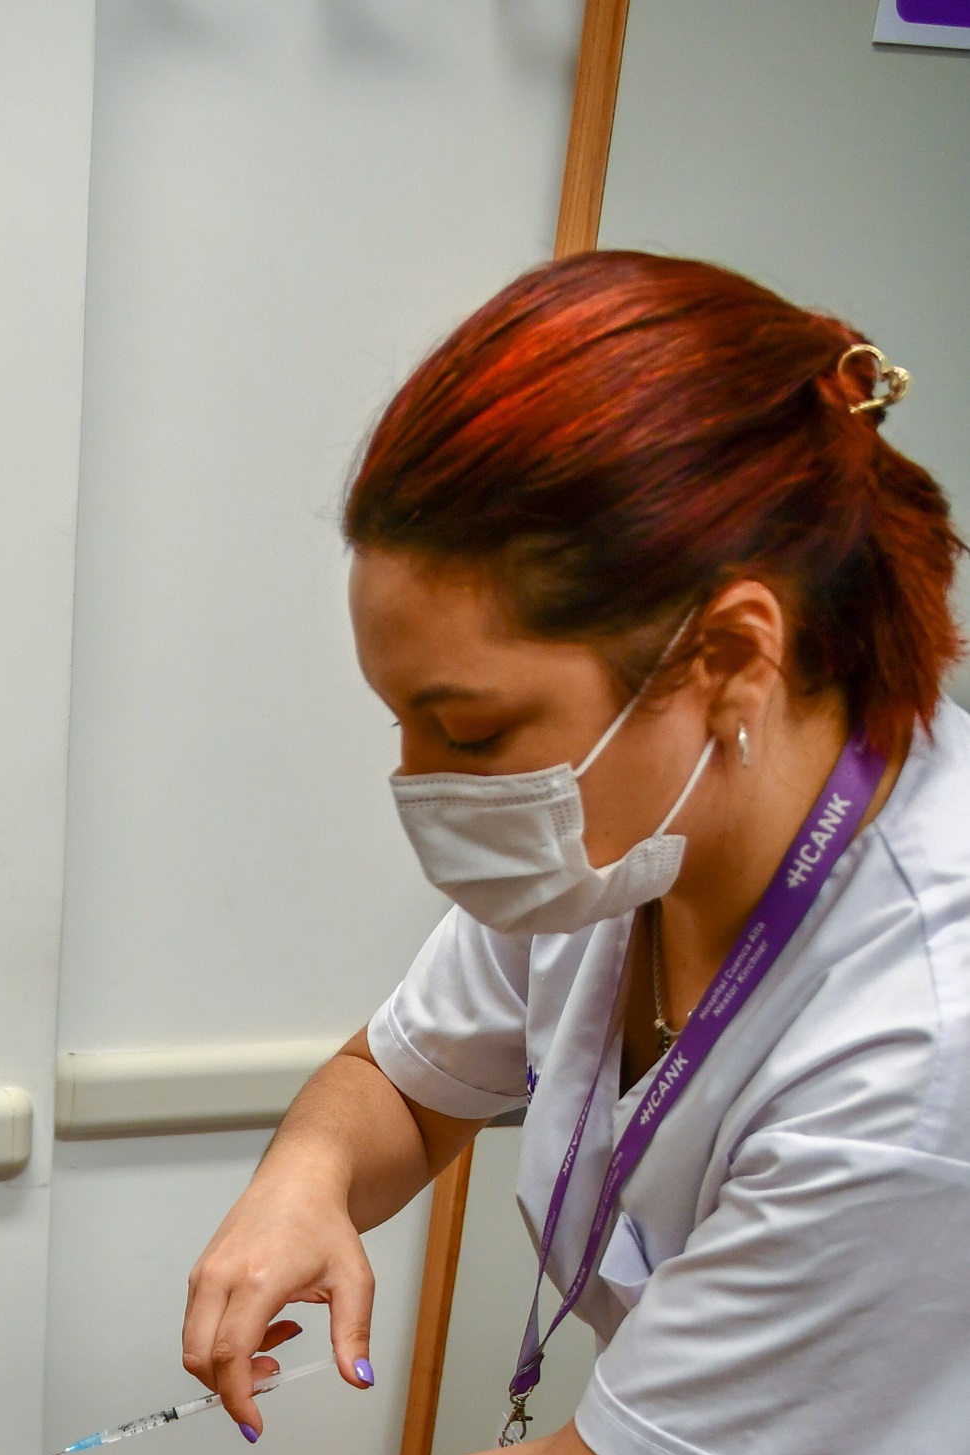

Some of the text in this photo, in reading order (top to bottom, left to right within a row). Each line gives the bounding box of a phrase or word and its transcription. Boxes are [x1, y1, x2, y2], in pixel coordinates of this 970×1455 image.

[787, 793, 852, 885] HCANK
[699, 978, 728, 1020] Hospital
[748, 922, 766, 943] Alta
[640, 1050, 689, 1123] HCANK
